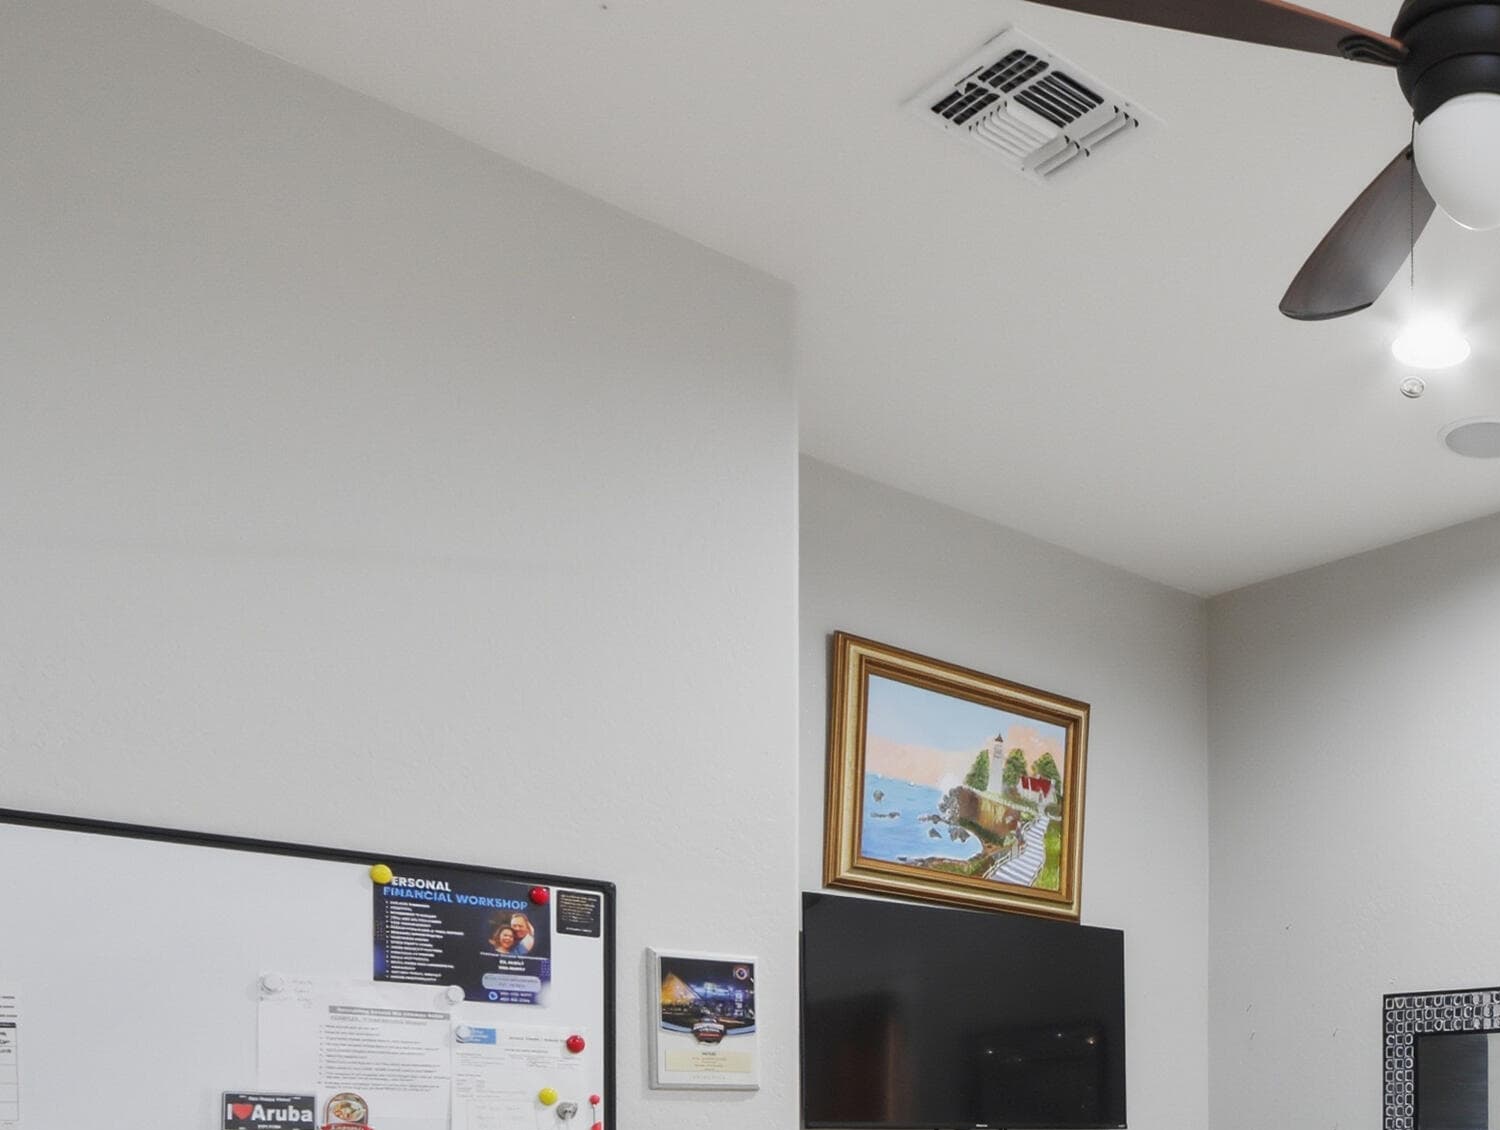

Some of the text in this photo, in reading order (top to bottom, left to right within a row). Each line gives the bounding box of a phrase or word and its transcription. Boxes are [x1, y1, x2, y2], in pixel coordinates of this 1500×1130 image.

[392, 876, 451, 892] ERSONAL
[383, 886, 528, 910] FINANCIAL WORKSHOP
[227, 1103, 313, 1122] I Aruba
